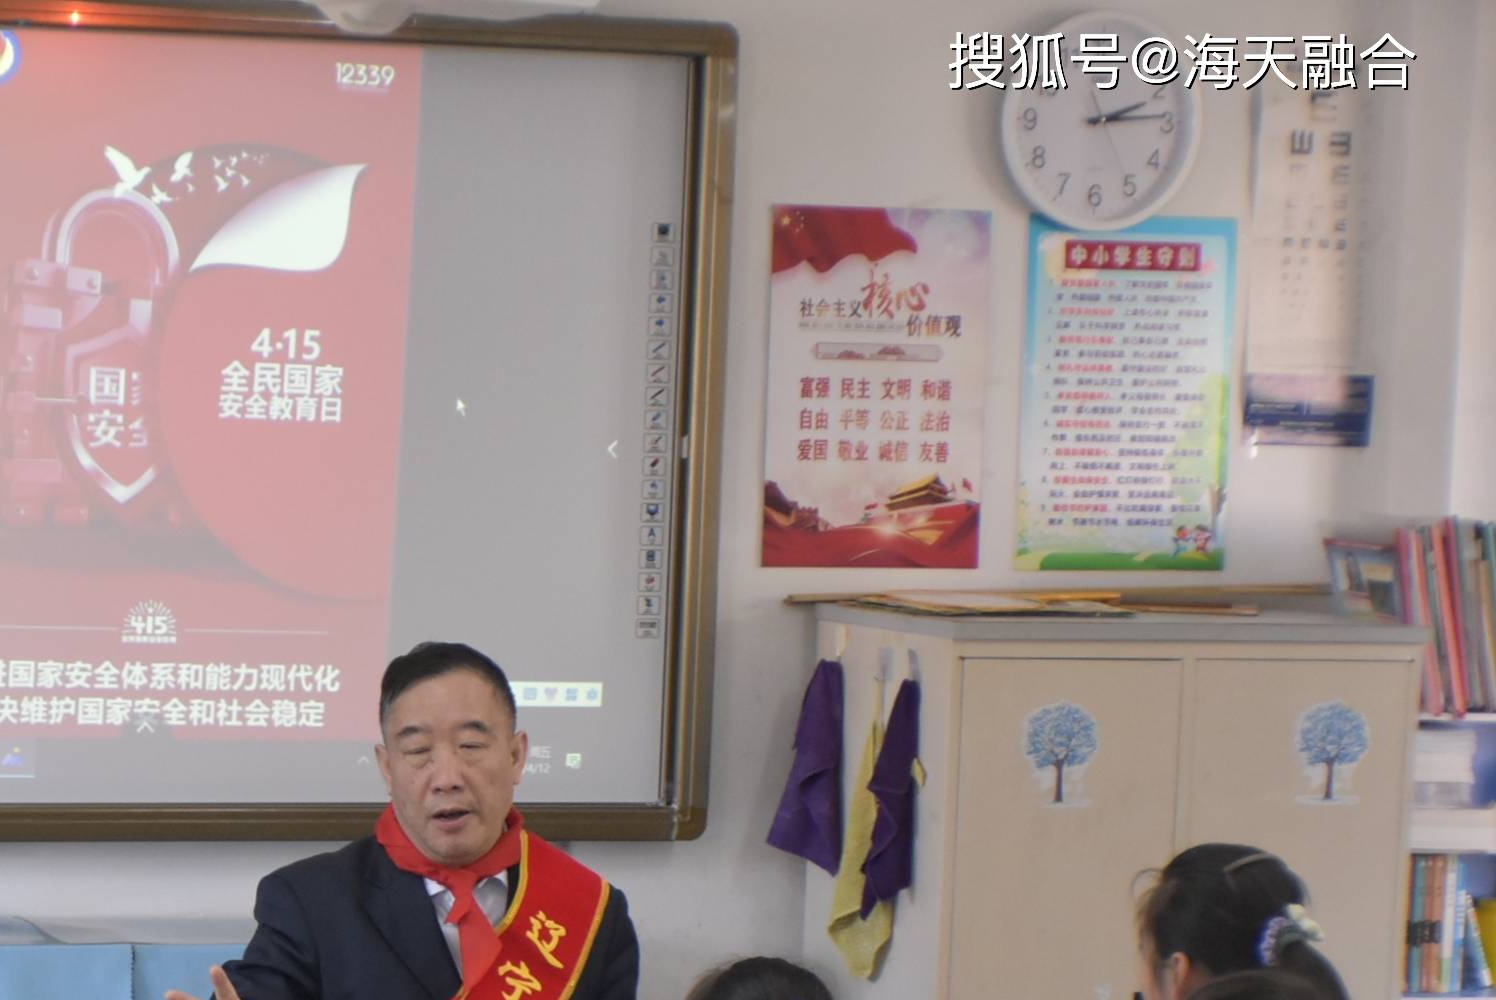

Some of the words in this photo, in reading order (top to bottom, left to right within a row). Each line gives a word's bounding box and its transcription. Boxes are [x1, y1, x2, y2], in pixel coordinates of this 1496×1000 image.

[336, 62, 395, 85] 12339
[1023, 107, 1038, 130] 9
[1160, 111, 1174, 134] 3
[1031, 145, 1046, 169] 8
[1146, 149, 1161, 169] 4
[1057, 173, 1071, 195] 7
[1087, 184, 1102, 207] 6
[1122, 174, 1137, 197] 5
[1070, 243, 1197, 269] 中小学生守则
[800, 298, 863, 319] 社会主义
[860, 263, 931, 320] 核心
[906, 314, 963, 338] 价值观
[220, 360, 345, 396] 全民国家
[800, 376, 830, 399] 富强
[840, 377, 871, 399] 民主
[880, 378, 912, 401] 文明
[921, 379, 952, 401] 和谐
[218, 393, 342, 423] 安全教育日
[799, 408, 829, 430] 自由
[839, 409, 871, 430] 平等
[880, 410, 911, 431] 公正
[920, 410, 951, 432] 法治
[797, 439, 829, 461] 爱国
[838, 440, 868, 462] 敬业
[878, 441, 909, 462] 诚信
[919, 441, 949, 463] 友善
